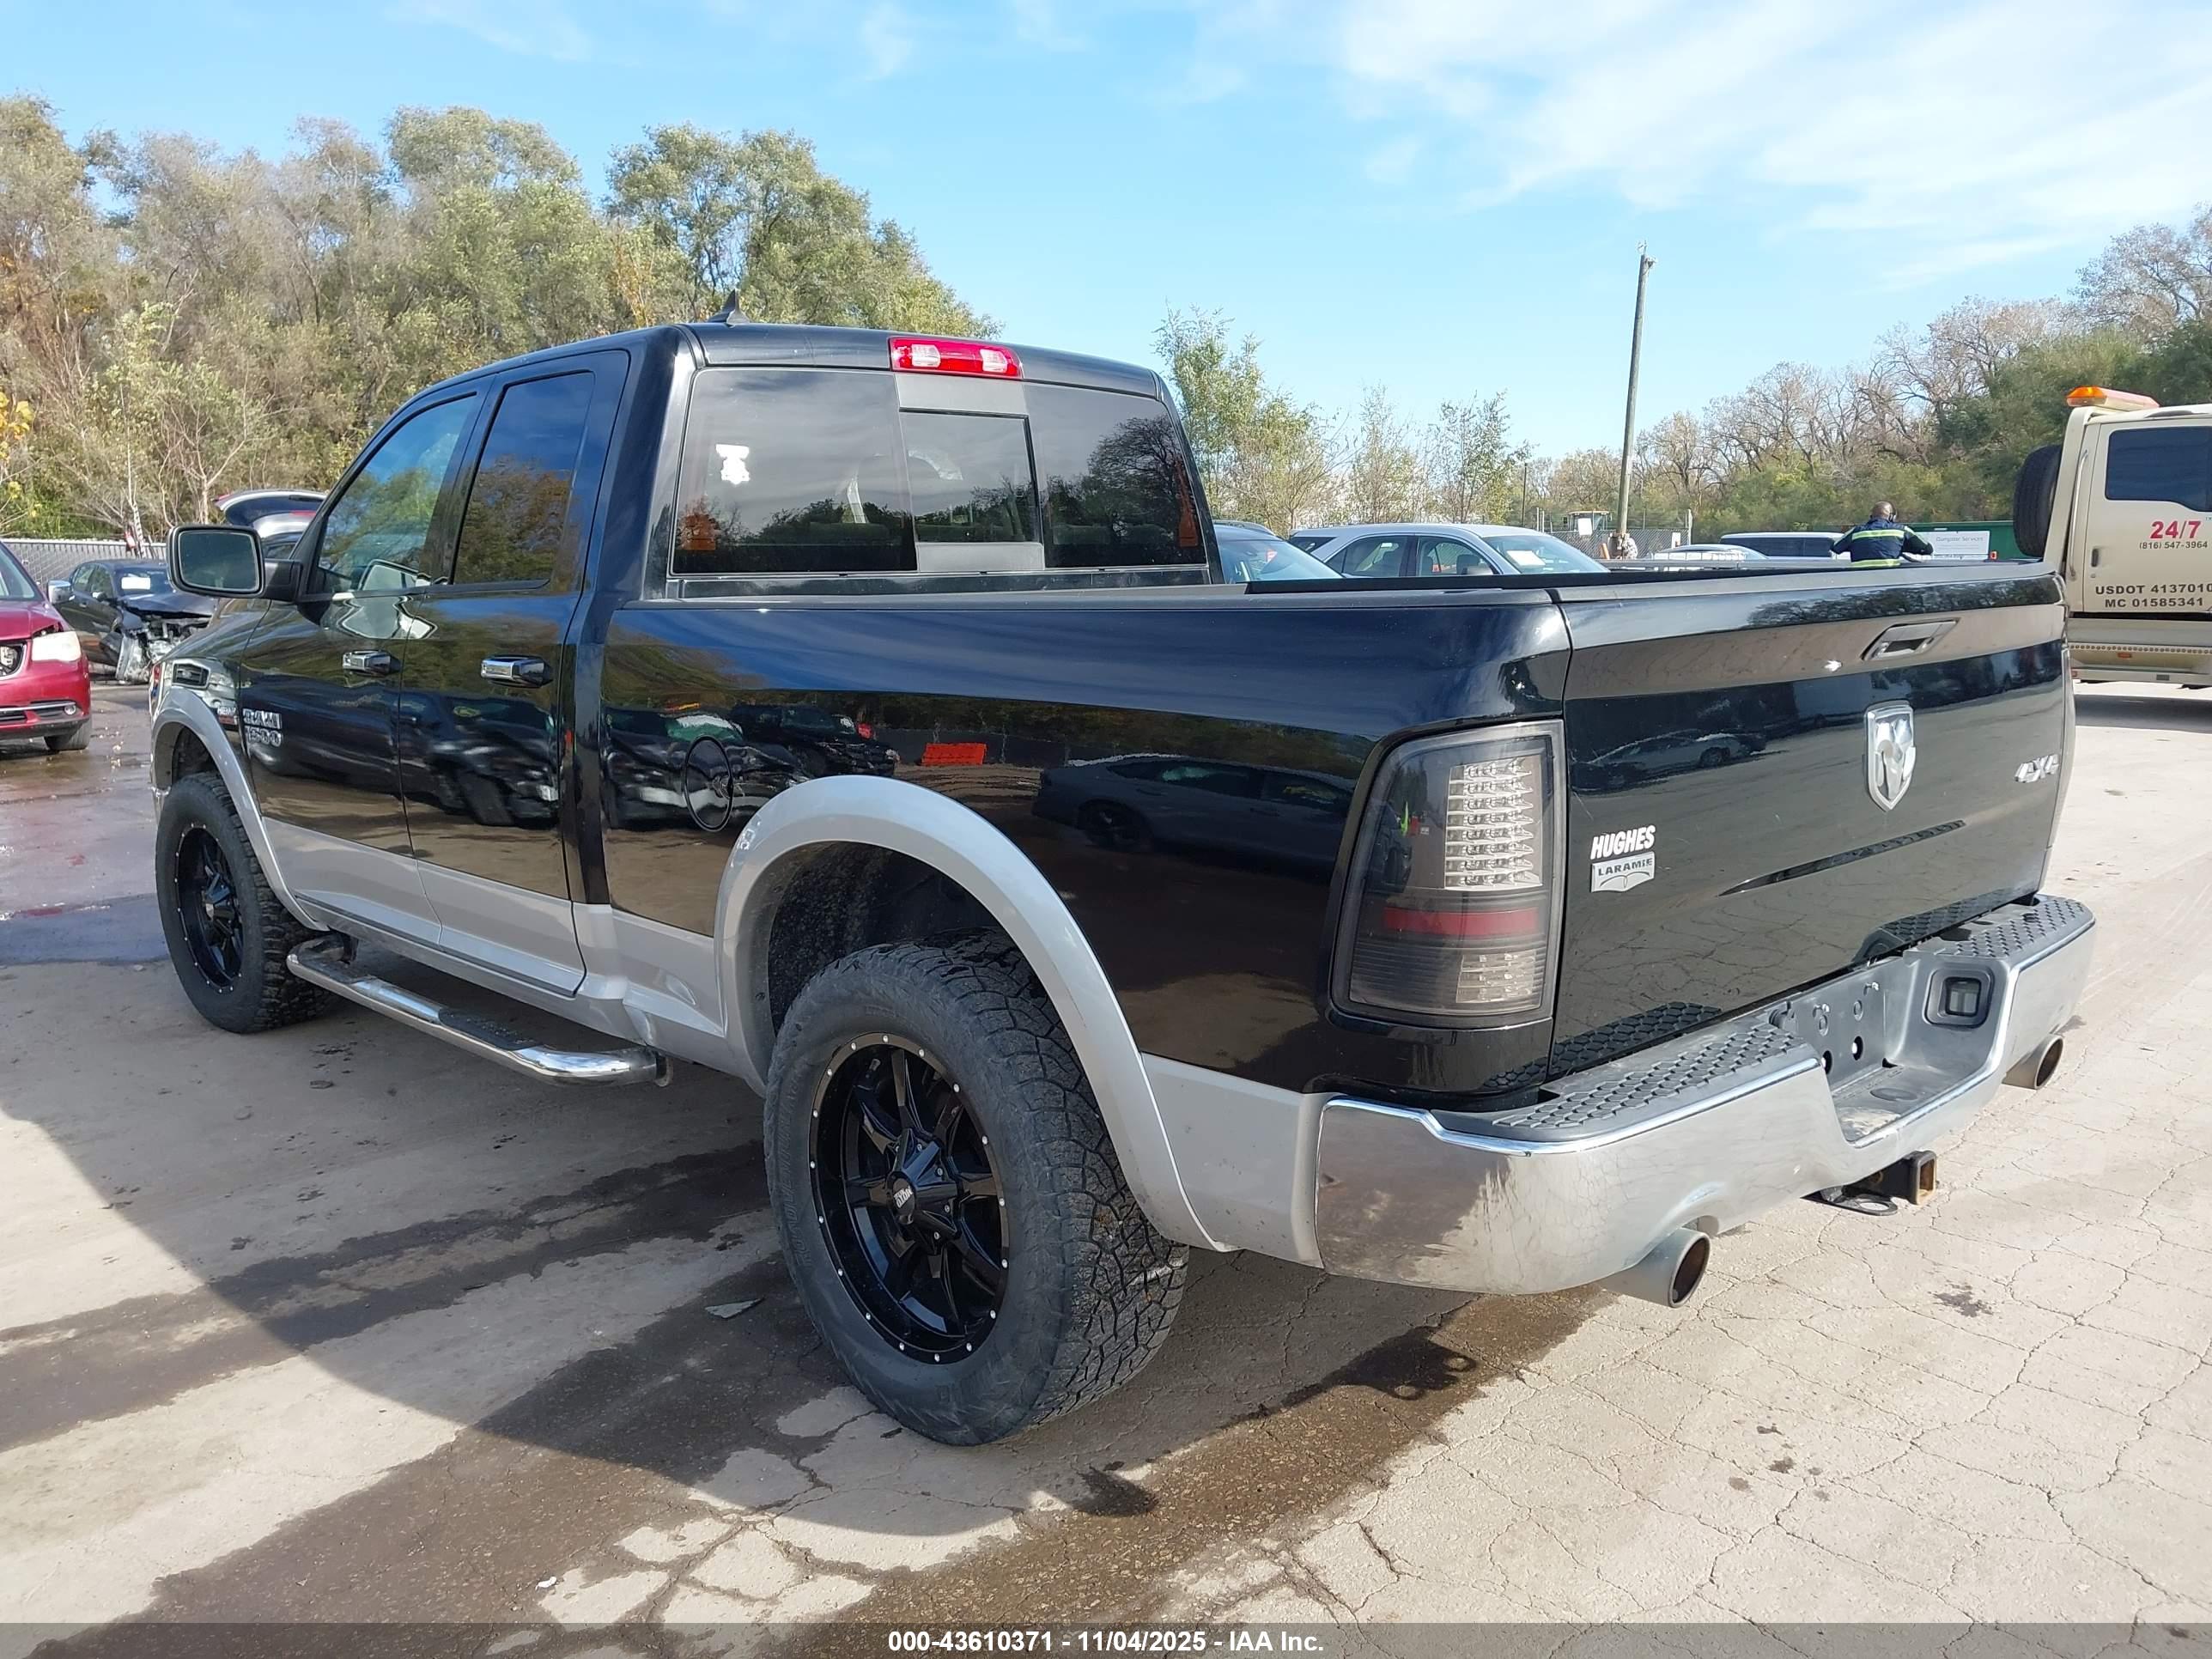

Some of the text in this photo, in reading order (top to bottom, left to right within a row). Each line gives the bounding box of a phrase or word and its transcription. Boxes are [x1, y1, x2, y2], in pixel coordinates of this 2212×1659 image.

[2149, 520, 2201, 538] 24/7
[2164, 541, 2208, 550] 547-3964
[2095, 584, 2212, 594] USDOT 4137010
[2105, 598, 2203, 608] MC 01585341
[242, 708, 282, 729] RAM
[245, 726, 283, 747] 1500
[1589, 824, 1656, 860] HUGHES
[1599, 858, 1654, 876] LARAMIE
